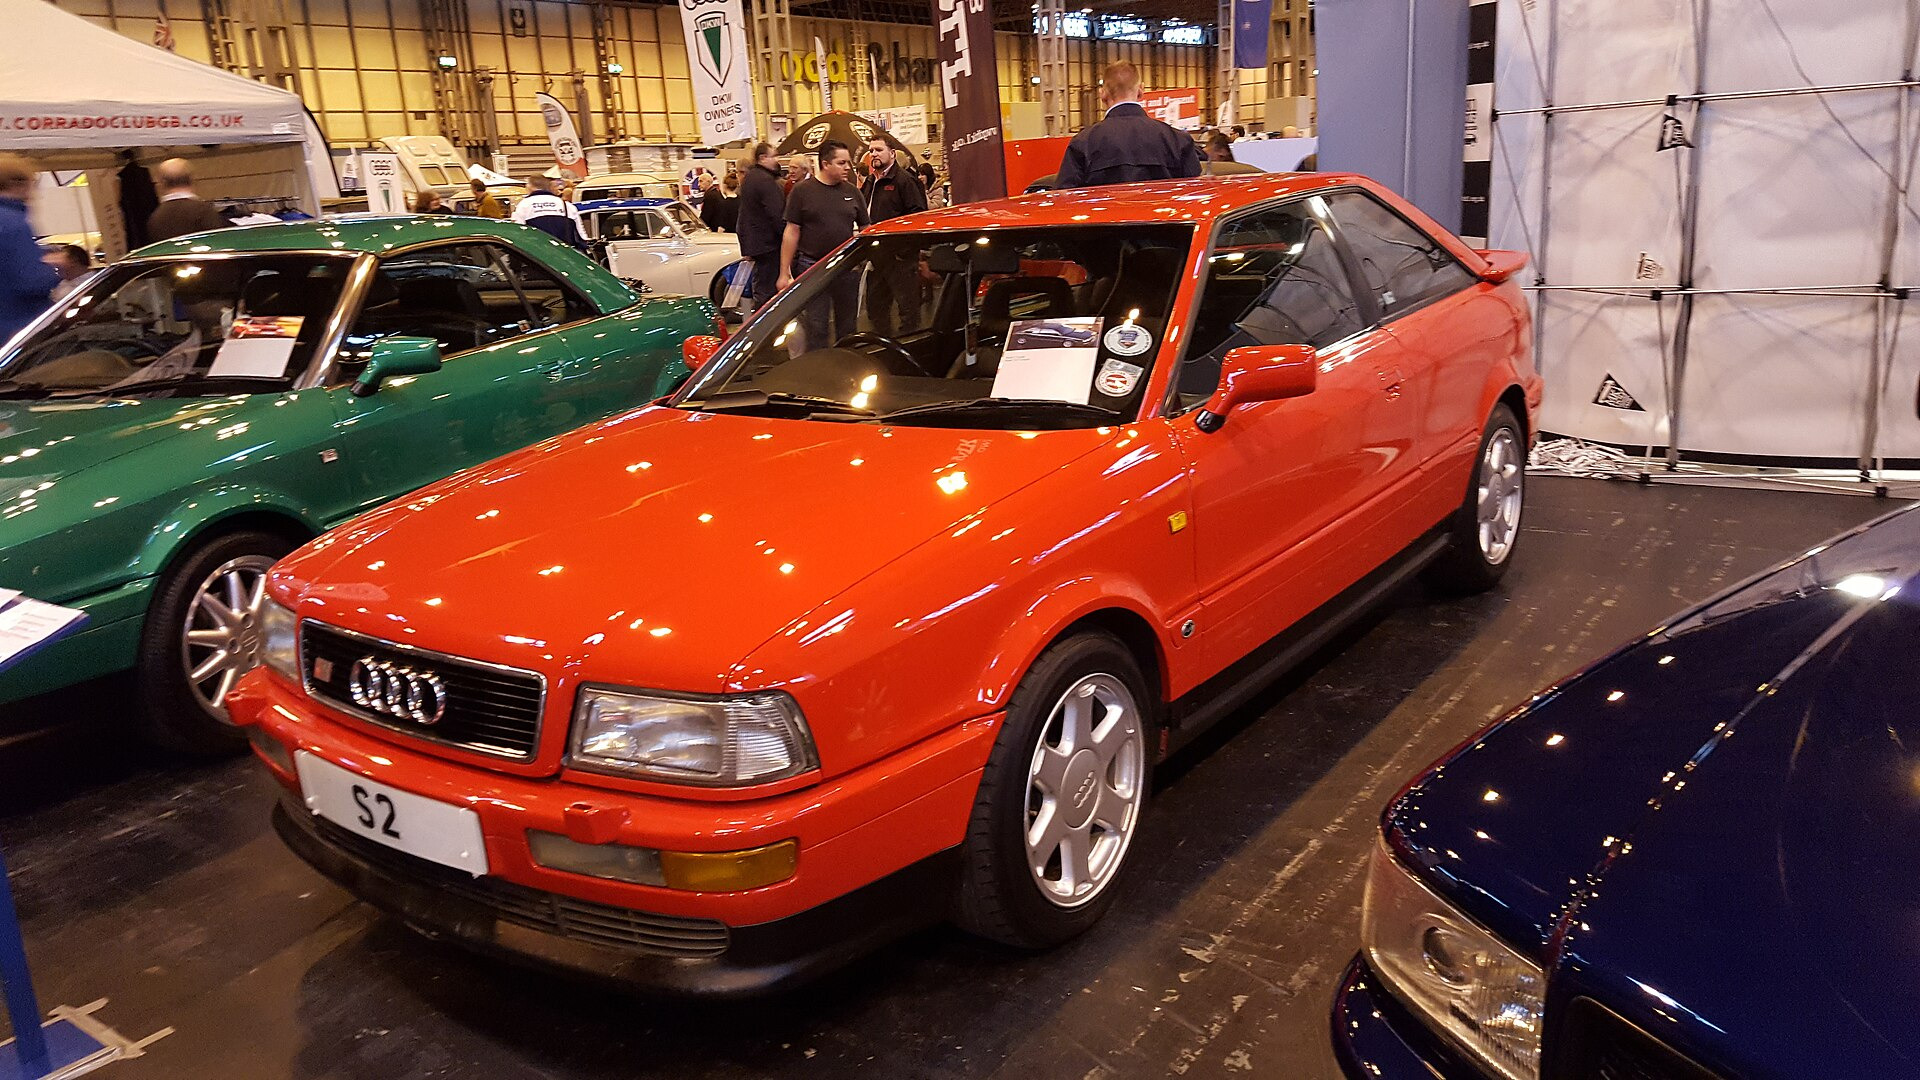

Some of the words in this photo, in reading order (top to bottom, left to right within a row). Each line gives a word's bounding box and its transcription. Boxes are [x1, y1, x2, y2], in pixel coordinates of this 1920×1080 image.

[711, 92, 732, 106] DKW
[704, 103, 742, 121] OWNERS
[0, 114, 244, 130] .CORRADOCLUBGB.CO.UK
[715, 119, 735, 133] CLUB
[352, 784, 400, 840] S2
